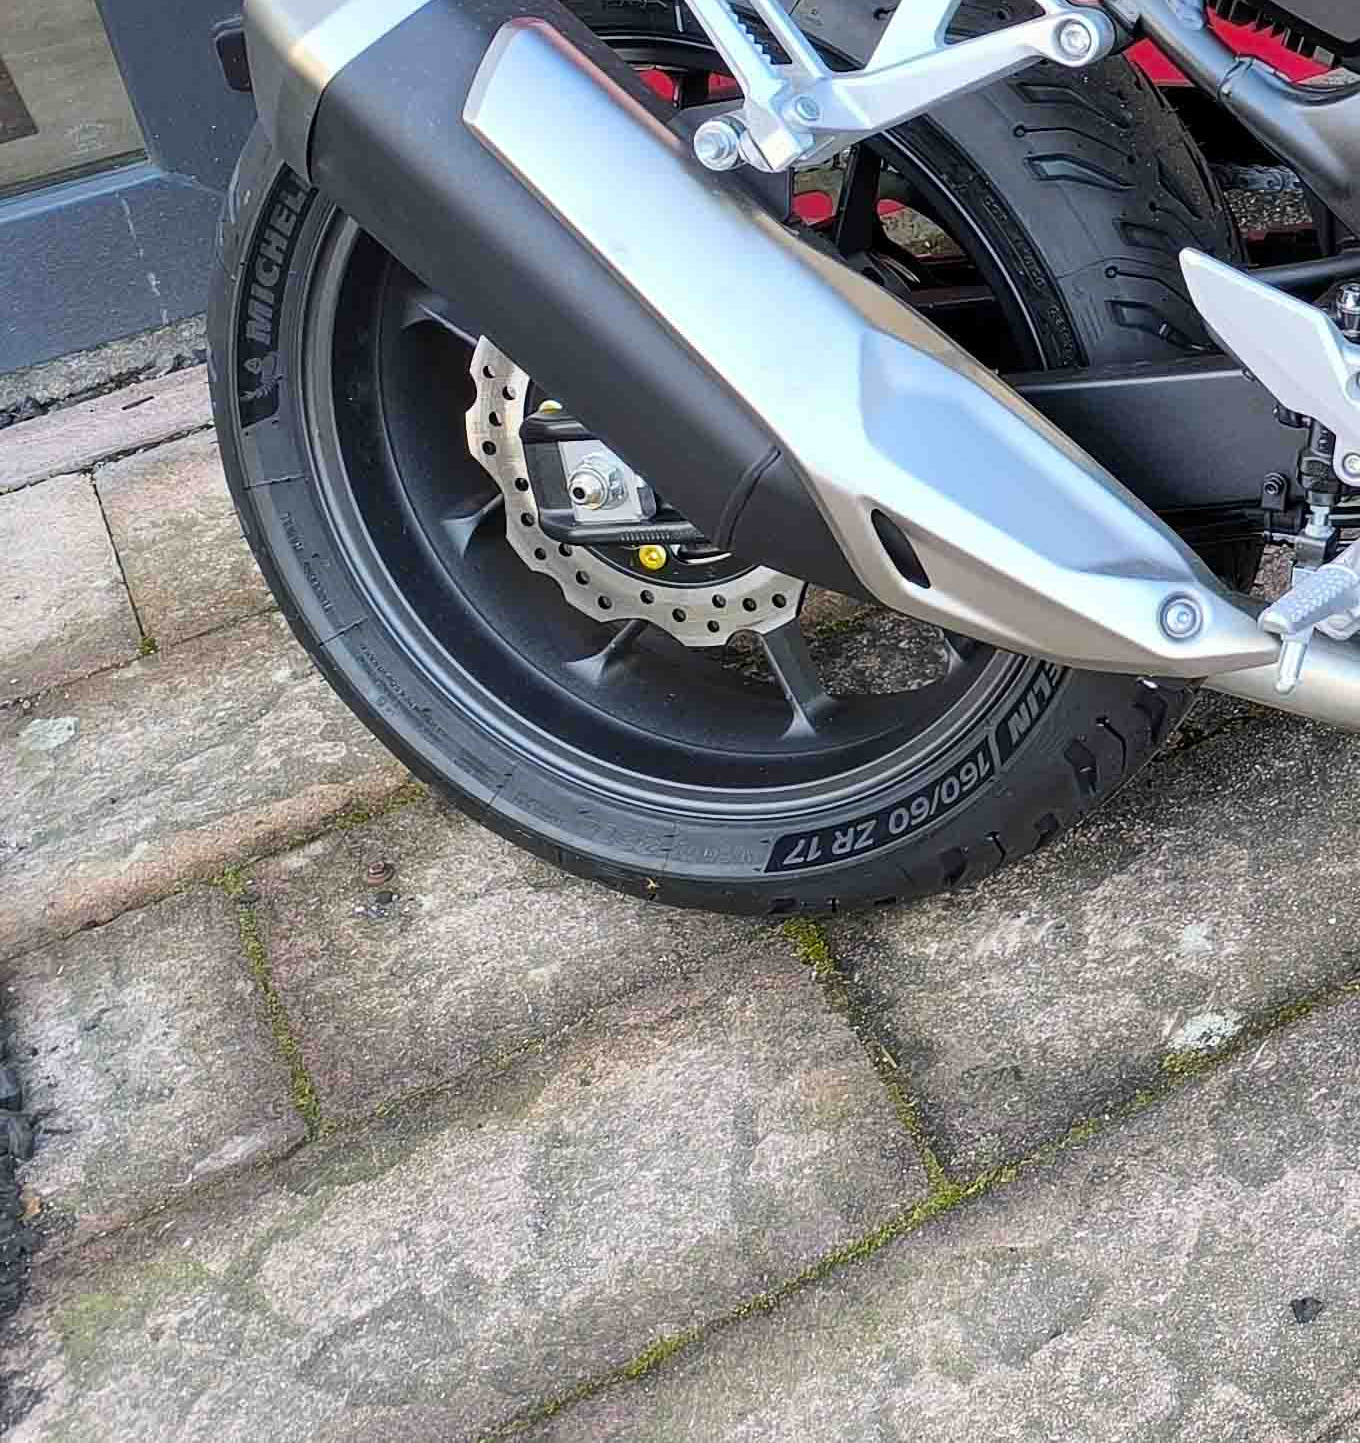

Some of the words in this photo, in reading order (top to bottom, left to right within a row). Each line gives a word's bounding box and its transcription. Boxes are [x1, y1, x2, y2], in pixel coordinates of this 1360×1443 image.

[245, 176, 312, 346] MICHEL
[888, 737, 992, 836] 160/60
[782, 835, 822, 866] 17
[831, 819, 878, 857] ZR
